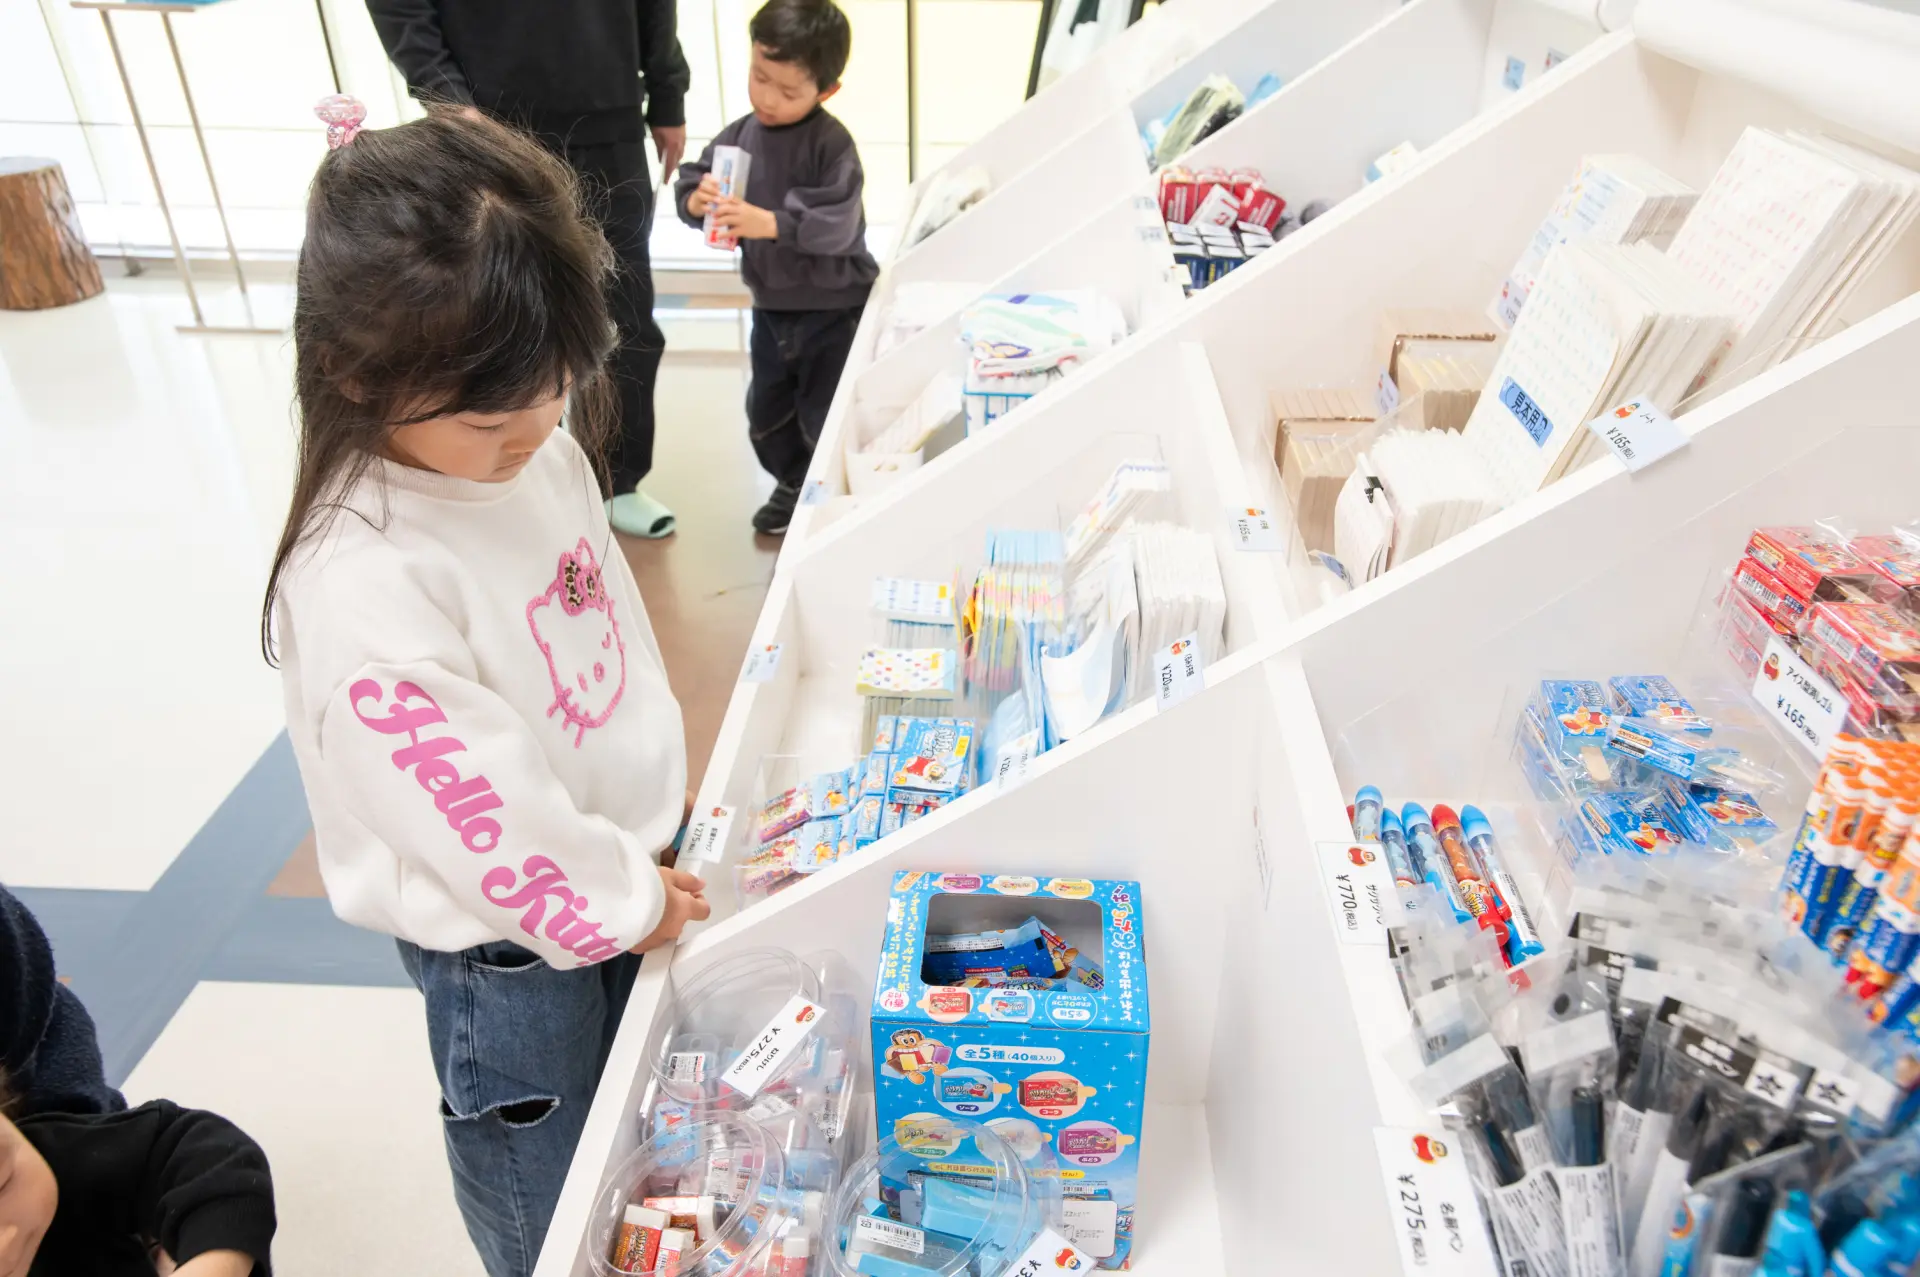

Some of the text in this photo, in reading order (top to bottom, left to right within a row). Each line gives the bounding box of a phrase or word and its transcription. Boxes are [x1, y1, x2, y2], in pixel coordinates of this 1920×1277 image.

[1639, 411, 1655, 425] ノート
[349, 678, 505, 854] Hello
[1336, 874, 1358, 931] ¥770(税込)
[884, 998, 905, 1008] 香り
[1059, 1009, 1084, 1019] 全5種
[733, 1026, 782, 1076] ¥275(税込)
[755, 1047, 780, 1073] ねりけし
[1440, 1201, 1464, 1254] 名前ペン
[1013, 1258, 1043, 1277] ¥3
